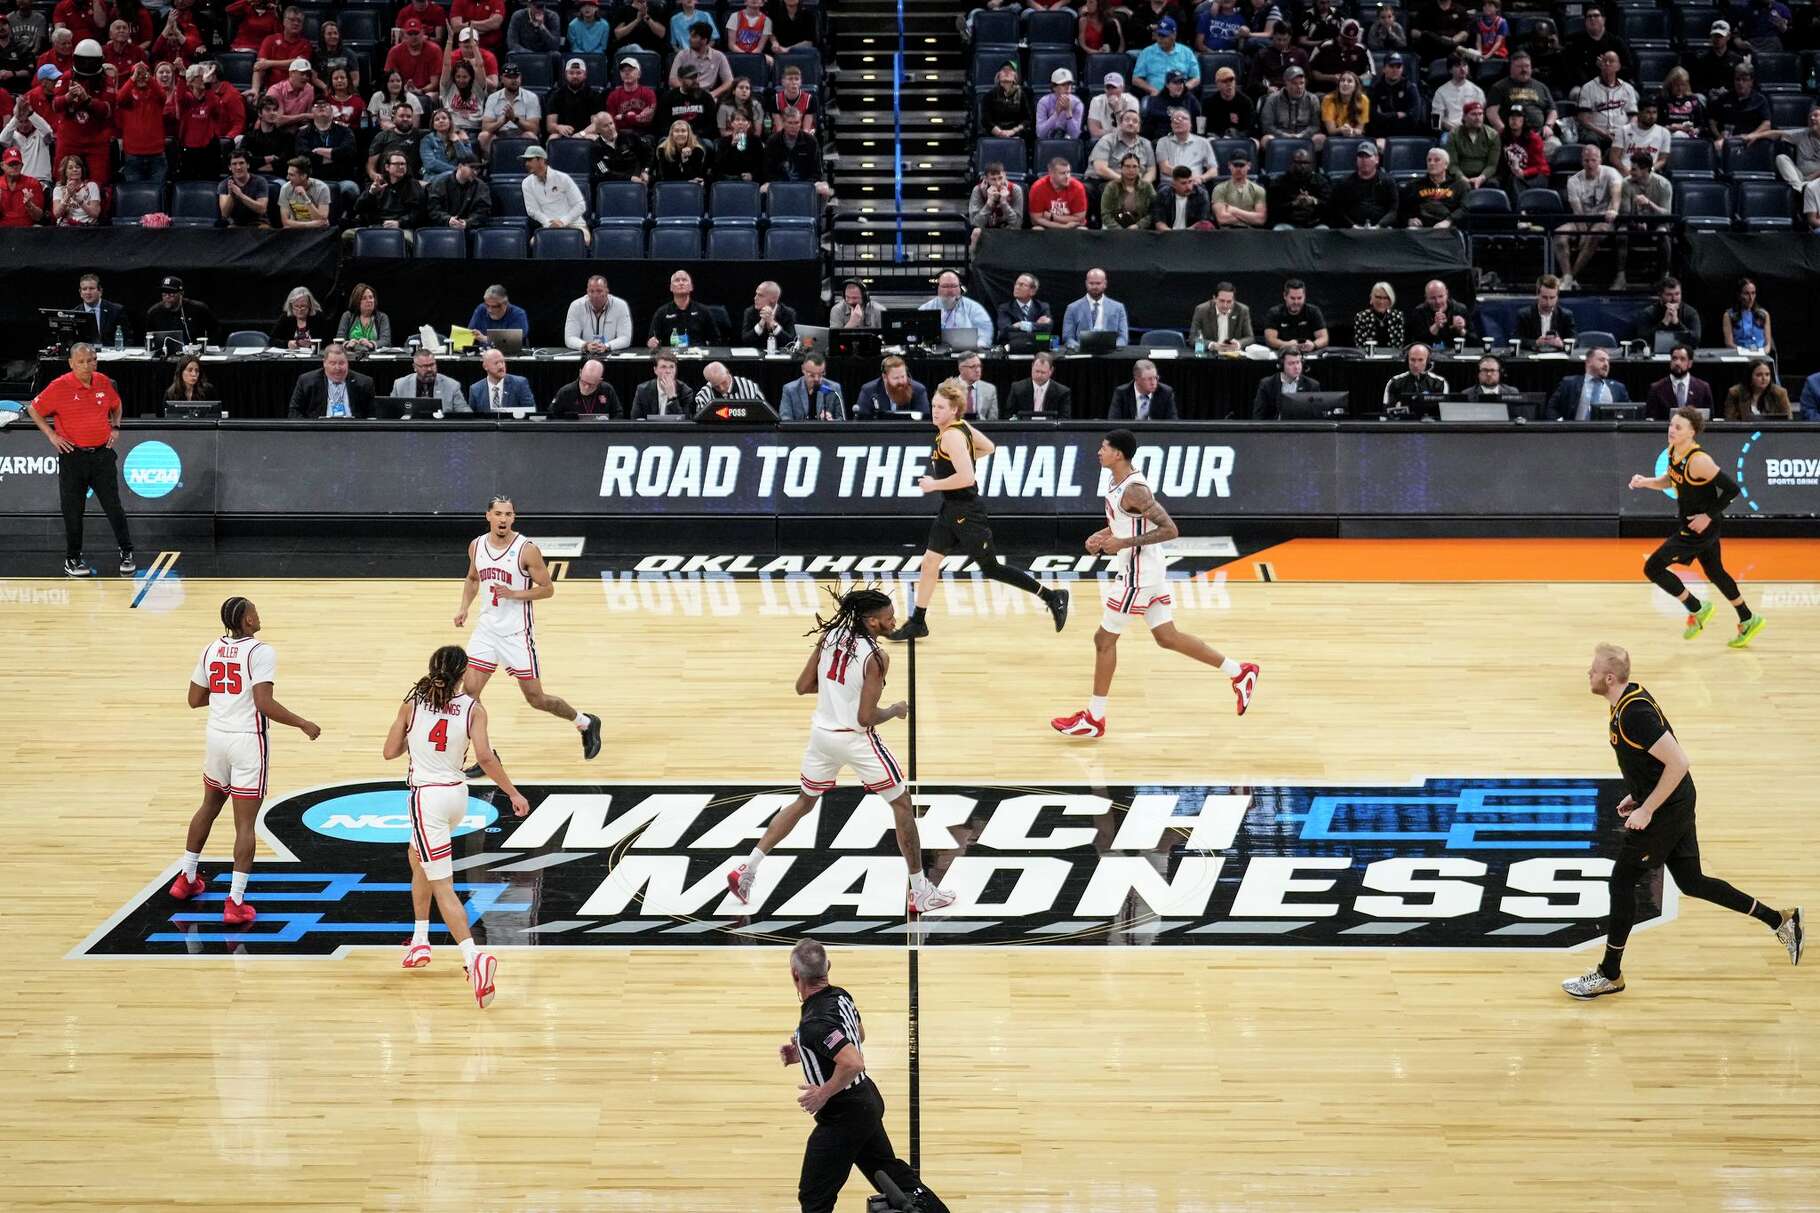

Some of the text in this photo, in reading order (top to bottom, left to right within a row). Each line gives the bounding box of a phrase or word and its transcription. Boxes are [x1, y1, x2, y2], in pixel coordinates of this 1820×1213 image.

[728, 408, 746, 417] POSS
[0, 456, 60, 475] ARMO
[128, 467, 180, 485] NCAA
[600, 445, 741, 498] ROAD
[756, 446, 821, 498] TO
[836, 446, 931, 498] THE
[974, 445, 1082, 498] INAL
[479, 567, 512, 585] HOUSTON
[216, 646, 239, 659] MILLER
[209, 661, 242, 695] 25
[826, 648, 851, 686] 11
[428, 718, 448, 752] 4
[319, 814, 487, 829] NCA
[500, 794, 1252, 850] MARCH
[574, 856, 1616, 919] MADNESS
